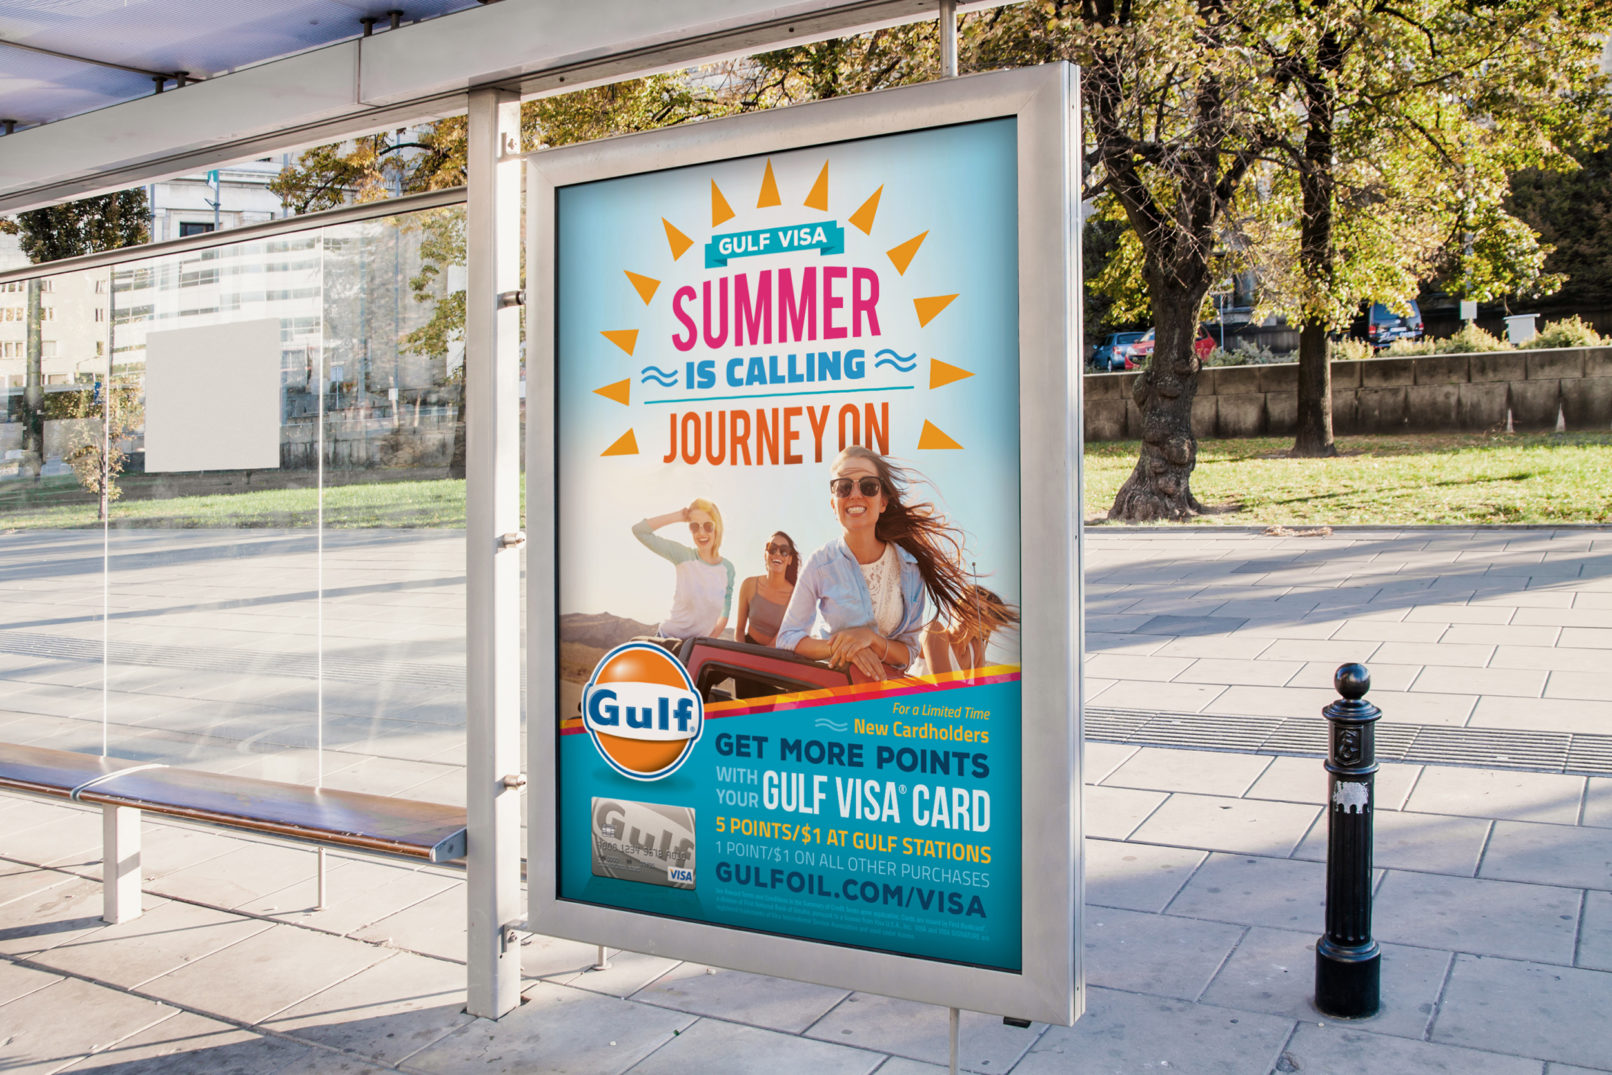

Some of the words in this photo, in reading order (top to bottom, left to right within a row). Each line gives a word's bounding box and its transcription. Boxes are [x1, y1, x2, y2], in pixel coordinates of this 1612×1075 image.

[719, 232, 771, 256] GULF
[777, 226, 827, 249] VISA
[671, 266, 881, 352] SUMMER
[685, 360, 716, 390] IS
[726, 348, 865, 387] CALLING
[663, 405, 831, 467] JOURNEY
[854, 718, 888, 736] New
[893, 721, 990, 744] Cardholders
[892, 702, 910, 715] For
[912, 706, 919, 716] a
[922, 703, 961, 719] Limited
[965, 706, 991, 721] Time
[715, 733, 768, 759] GET
[780, 738, 864, 768] MORE
[876, 746, 990, 779] POINTS
[716, 766, 758, 785] WITH
[716, 789, 759, 809] YOUR
[763, 770, 828, 815] GULF
[912, 784, 991, 833] CARD
[716, 816, 726, 832] 5
[730, 817, 821, 846] POINTS/$1
[826, 829, 849, 847] AT
[852, 832, 898, 853] GULF
[902, 837, 992, 864] STATIONS
[669, 868, 693, 881] VISA
[715, 840, 722, 854] 1
[727, 841, 790, 863] POINT/$1
[794, 850, 815, 867] ON
[819, 853, 844, 870] ALL
[848, 856, 897, 876] OTHER
[901, 863, 990, 888] PURCHASES
[715, 861, 988, 919] GULFOIL.COM/VISA
